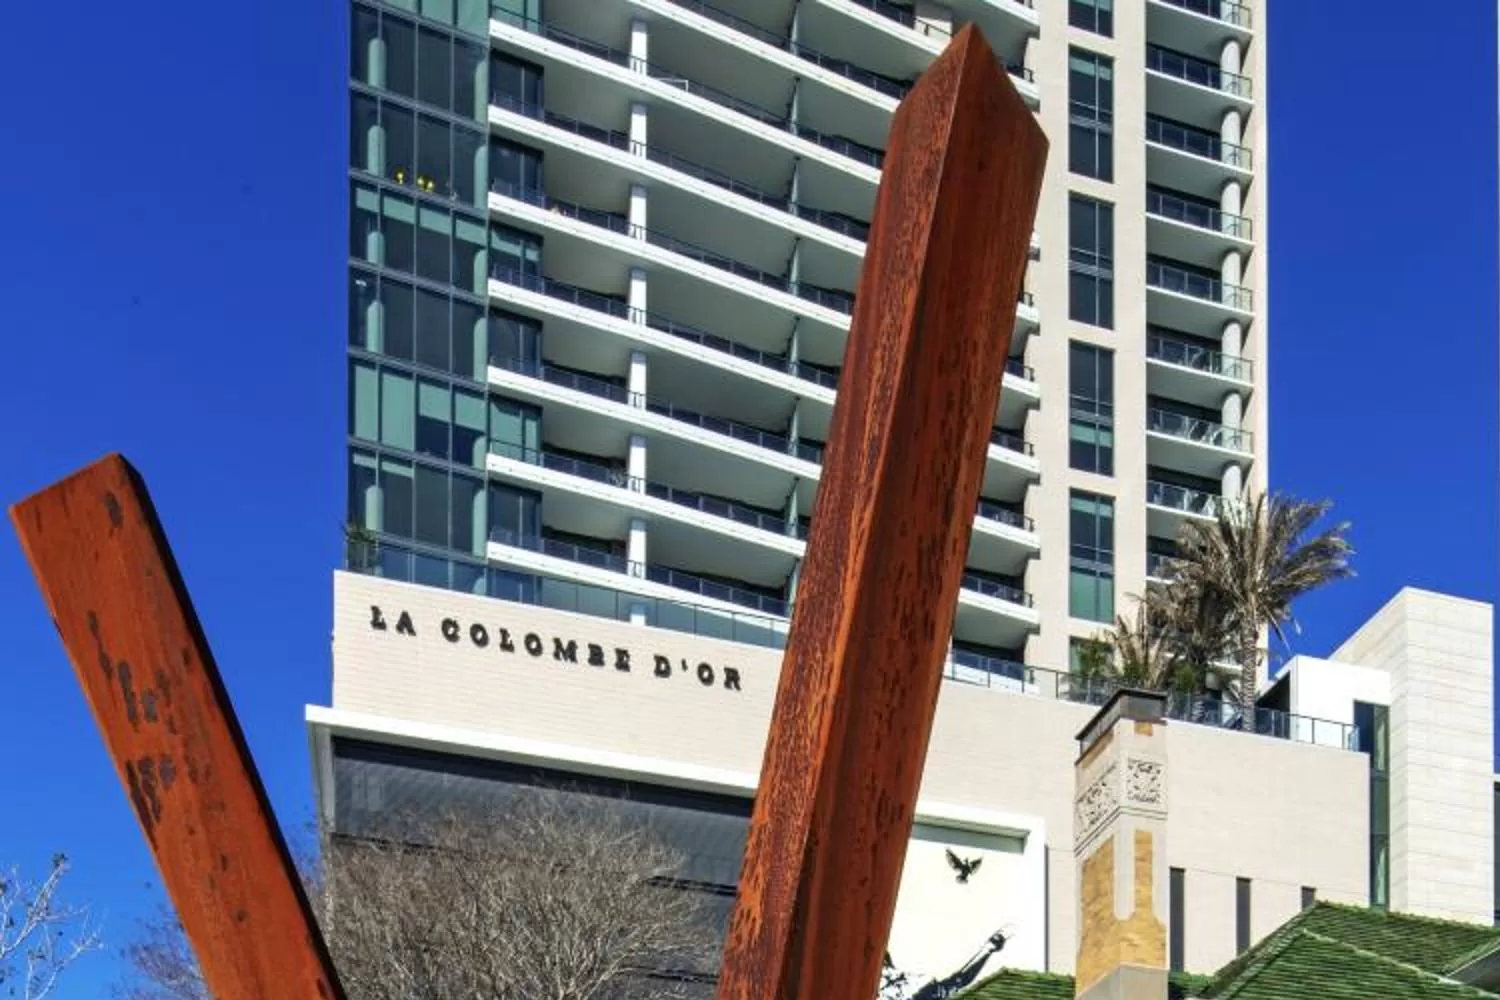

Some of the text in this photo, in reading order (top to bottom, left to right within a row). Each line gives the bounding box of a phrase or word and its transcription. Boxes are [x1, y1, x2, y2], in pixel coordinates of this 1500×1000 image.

[370, 605, 742, 691] LA COLOMBE D'OR
